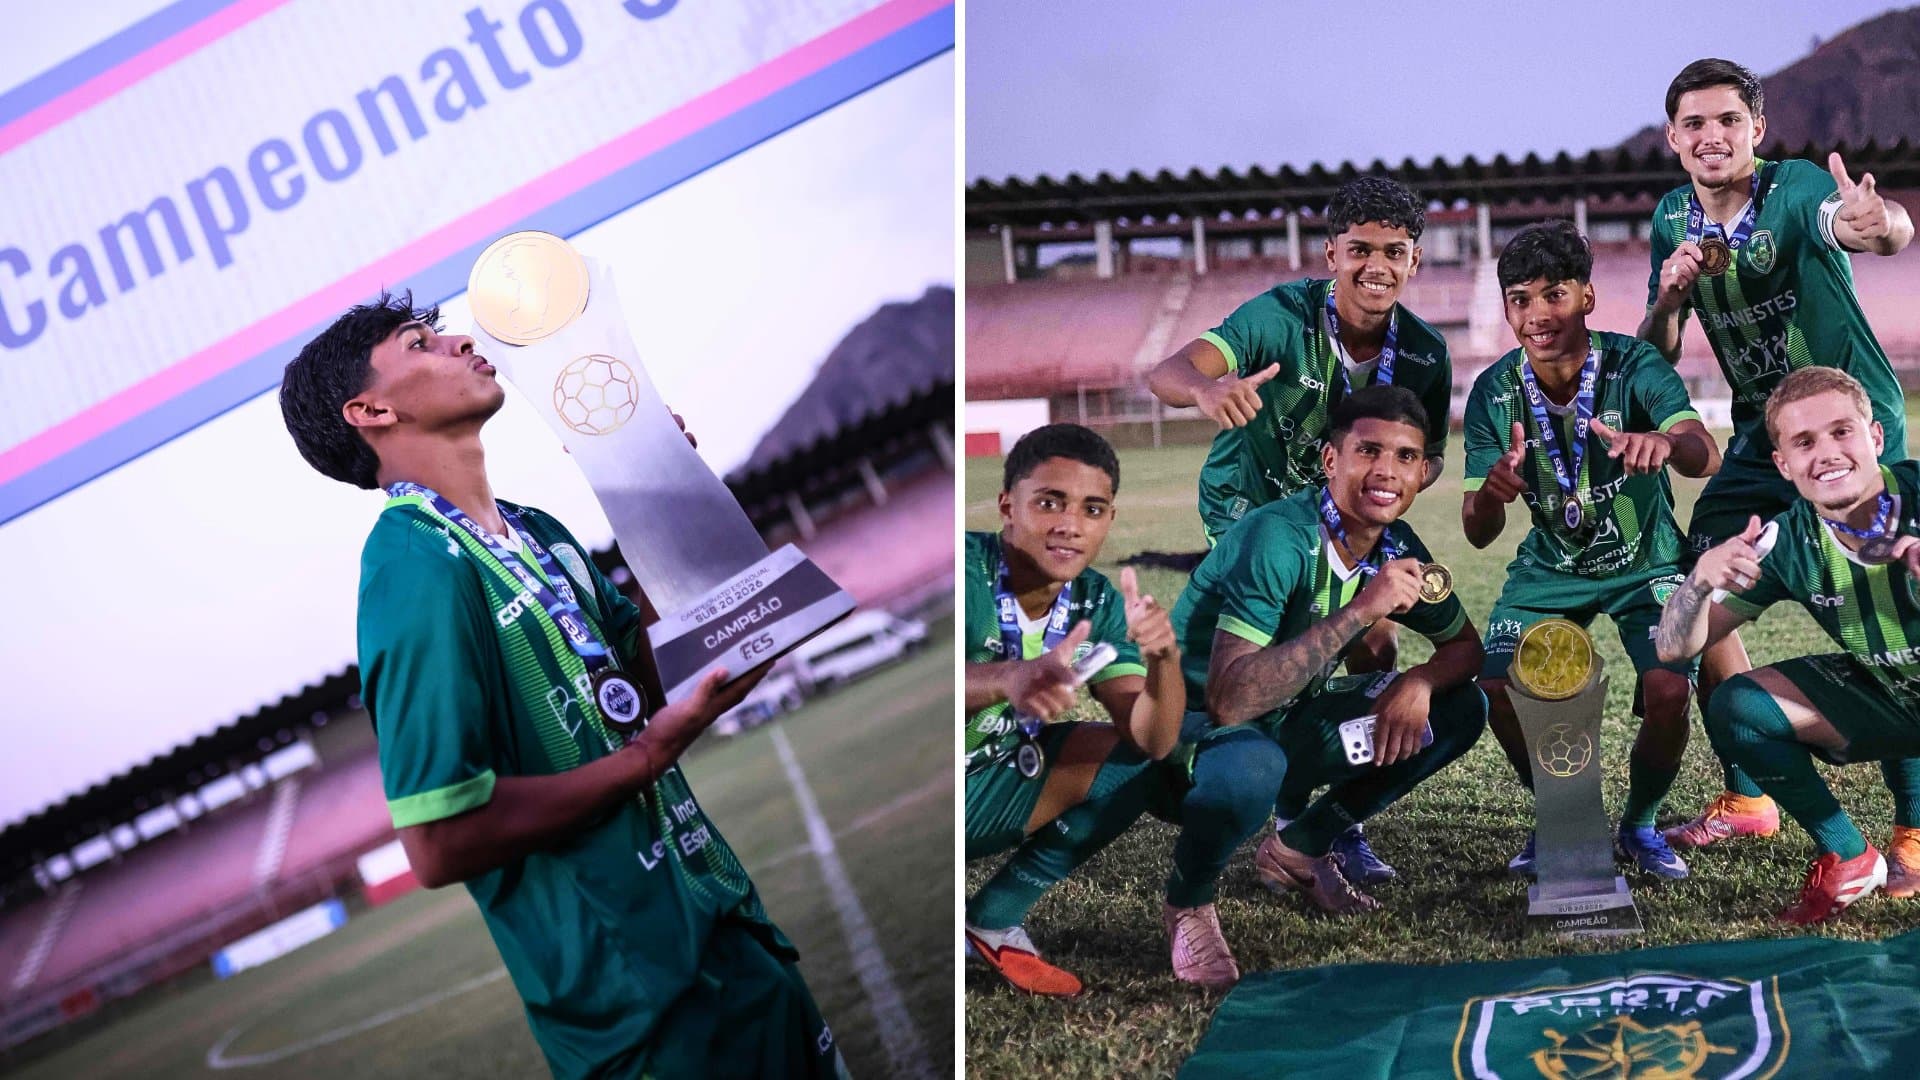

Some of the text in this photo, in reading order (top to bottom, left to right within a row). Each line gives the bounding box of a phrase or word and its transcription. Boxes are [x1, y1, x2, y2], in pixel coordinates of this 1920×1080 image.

[0, 0, 584, 349] Campeonato
[1712, 290, 1797, 329] BANESTES
[731, 567, 769, 594] ESTADUAL
[735, 579, 765, 601] 2026
[558, 615, 588, 646] FES
[704, 596, 783, 649] CAMPEÃO
[739, 632, 774, 661] FES
[1556, 915, 1608, 929] CAMPEÃO
